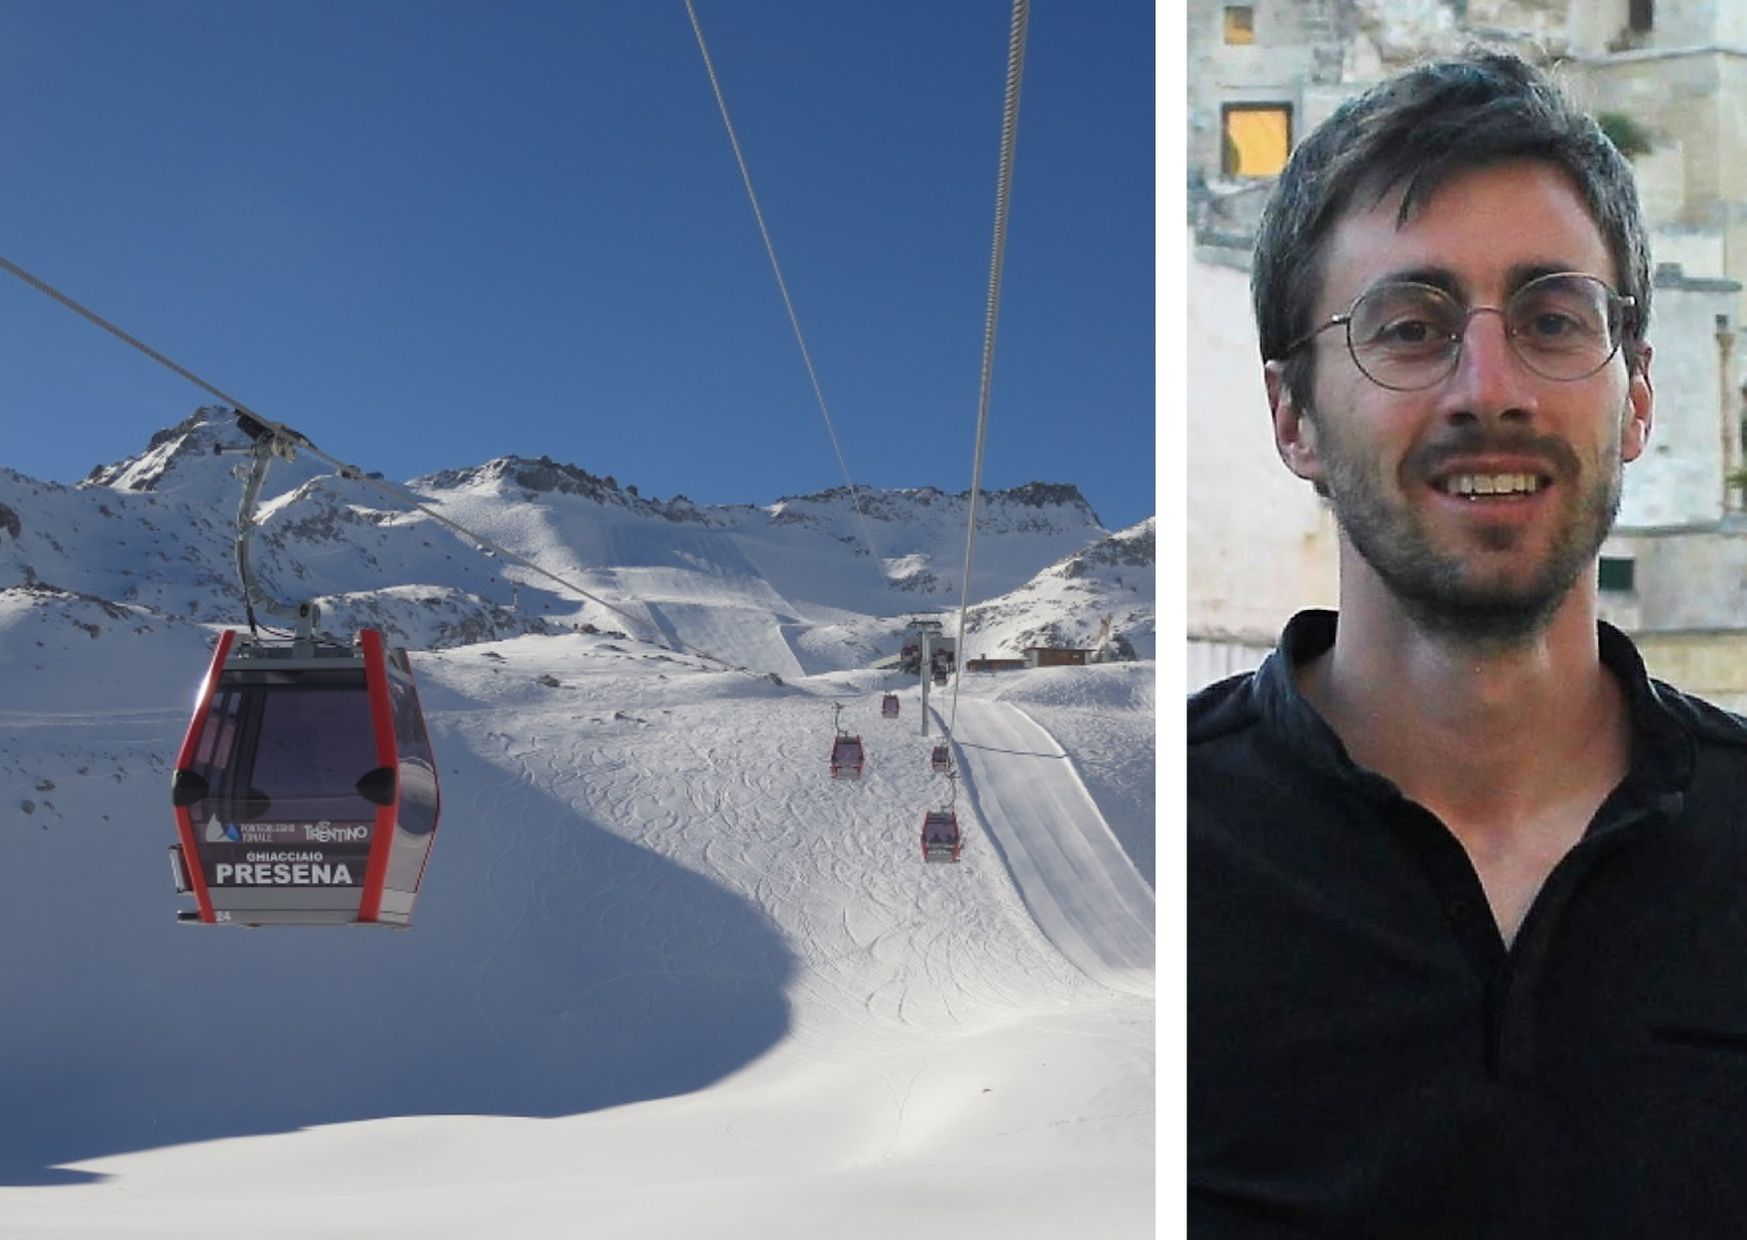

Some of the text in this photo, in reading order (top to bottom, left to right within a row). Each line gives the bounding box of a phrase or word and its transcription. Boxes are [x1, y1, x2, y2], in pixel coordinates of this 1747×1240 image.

[303, 821, 368, 842] TRENTINO
[246, 851, 323, 862] GHIACCIAIO
[216, 863, 353, 884] PRESENA
